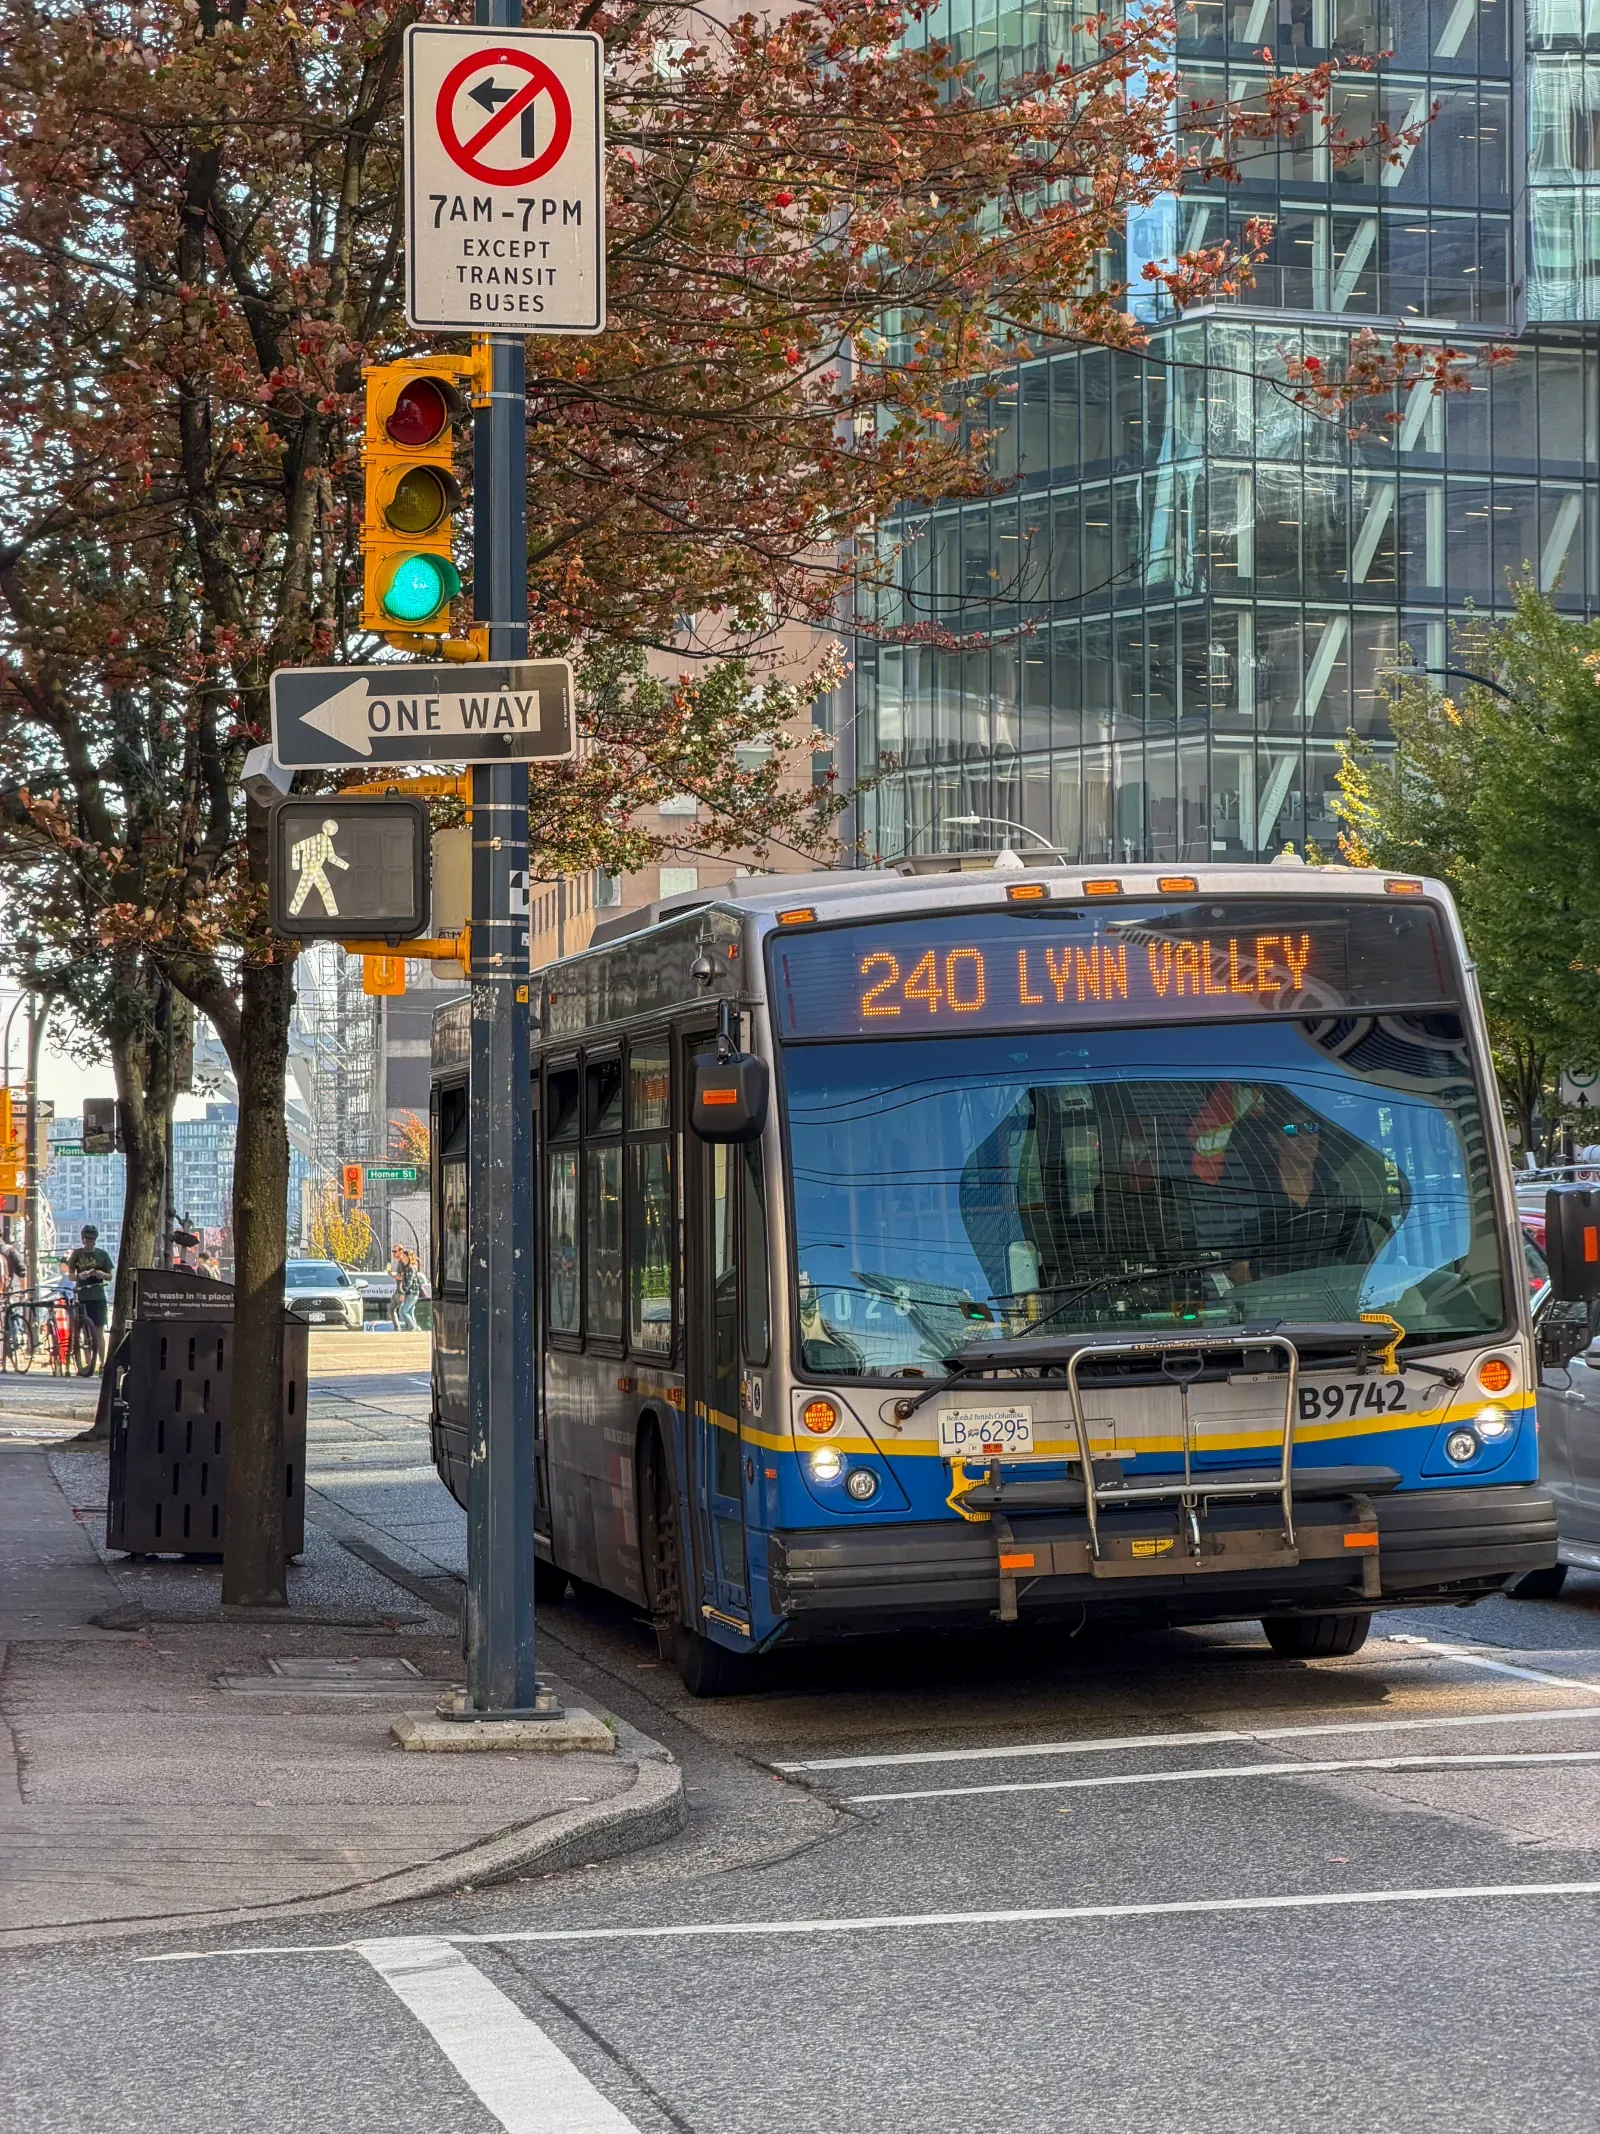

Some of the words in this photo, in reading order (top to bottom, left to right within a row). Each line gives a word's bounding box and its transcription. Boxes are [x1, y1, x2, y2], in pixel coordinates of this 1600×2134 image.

[429, 194, 582, 232] 7AM-7PM
[463, 238, 551, 259] EXCEPT
[456, 265, 557, 286] TRANSIT
[469, 292, 545, 313] BUSES
[367, 699, 441, 732] ONE
[458, 695, 534, 729] WAY
[859, 948, 987, 1017] 240
[1018, 944, 1129, 1005] LYNN
[1147, 932, 1312, 998] VALLEY
[370, 1170, 399, 1178] Homer
[402, 1170, 412, 1178] St
[159, 1292, 185, 1300] waste
[208, 1293, 234, 1301] place!
[1297, 1379, 1407, 1420] B9742
[994, 1411, 1024, 1419] Columbia
[979, 1418, 1029, 1442] 6295
